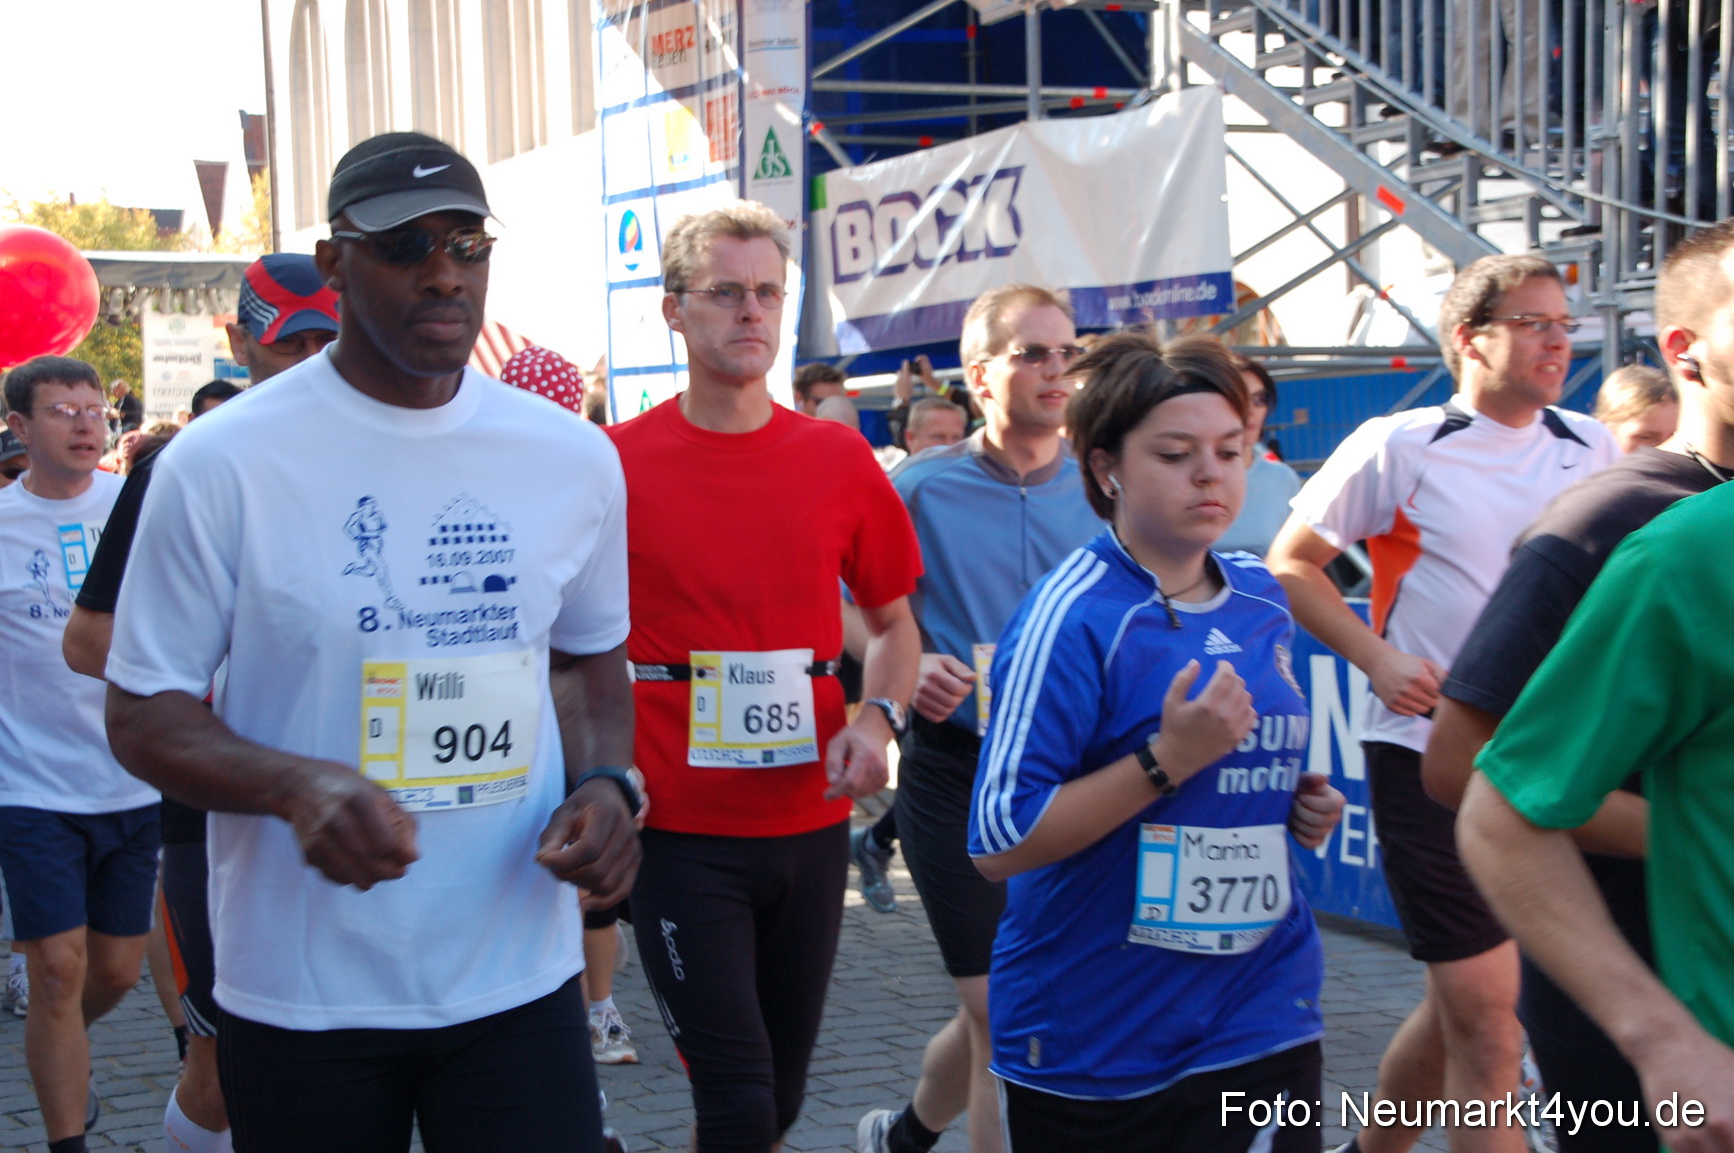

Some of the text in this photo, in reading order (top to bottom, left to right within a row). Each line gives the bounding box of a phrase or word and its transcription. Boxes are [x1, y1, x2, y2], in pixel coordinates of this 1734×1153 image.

[652, 25, 696, 55] MERZ
[830, 165, 1025, 285] BOCK
[426, 548, 515, 568] 16.09.2007
[30, 604, 49, 619] 8.
[358, 603, 518, 633] 8. Neumarkter
[426, 622, 519, 648] Stadtlauf
[415, 671, 465, 701] Willi
[728, 662, 776, 685] Klaus
[743, 702, 800, 735] 685
[433, 719, 513, 763] 904
[1183, 831, 1261, 861] Marina
[1188, 873, 1280, 914] 3770
